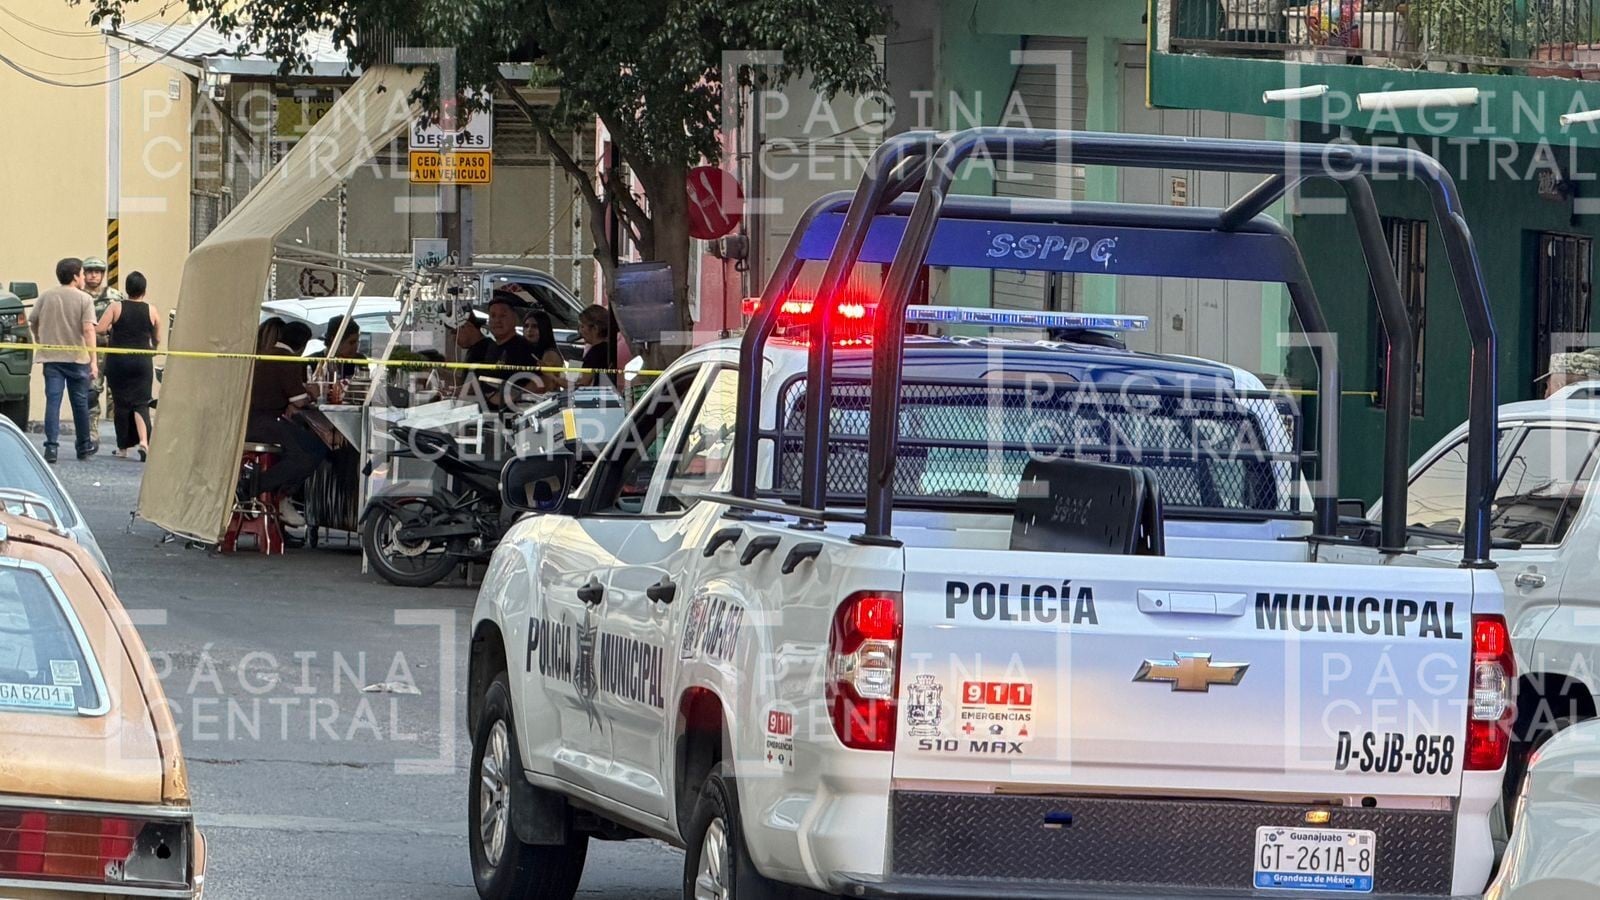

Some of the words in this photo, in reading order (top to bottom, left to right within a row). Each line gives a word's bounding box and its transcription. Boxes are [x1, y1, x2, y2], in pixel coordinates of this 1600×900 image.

[416, 133, 484, 146] DESUES
[417, 156, 442, 167] CEDA
[445, 156, 457, 167] EL
[460, 157, 485, 167] PASO
[422, 169, 436, 179] UN
[946, 579, 1099, 625] POLICÍA
[1255, 592, 1463, 640] MUNICIPAL
[526, 613, 571, 684] POLICÍA
[601, 632, 665, 710] MUNICIPAL
[966, 684, 1027, 703] 911
[769, 713, 791, 733] 911
[961, 711, 1031, 721] EMERGENCIAS
[918, 739, 959, 751] S10
[969, 740, 1023, 753] MAX
[1335, 730, 1455, 775] D-SJB-858
[1290, 832, 1342, 843] Guanajuato
[1261, 843, 1370, 873] GT-261A-8
[1273, 873, 1312, 883] Grandeza
[1314, 874, 1325, 883] de
[1326, 874, 1355, 884] México
